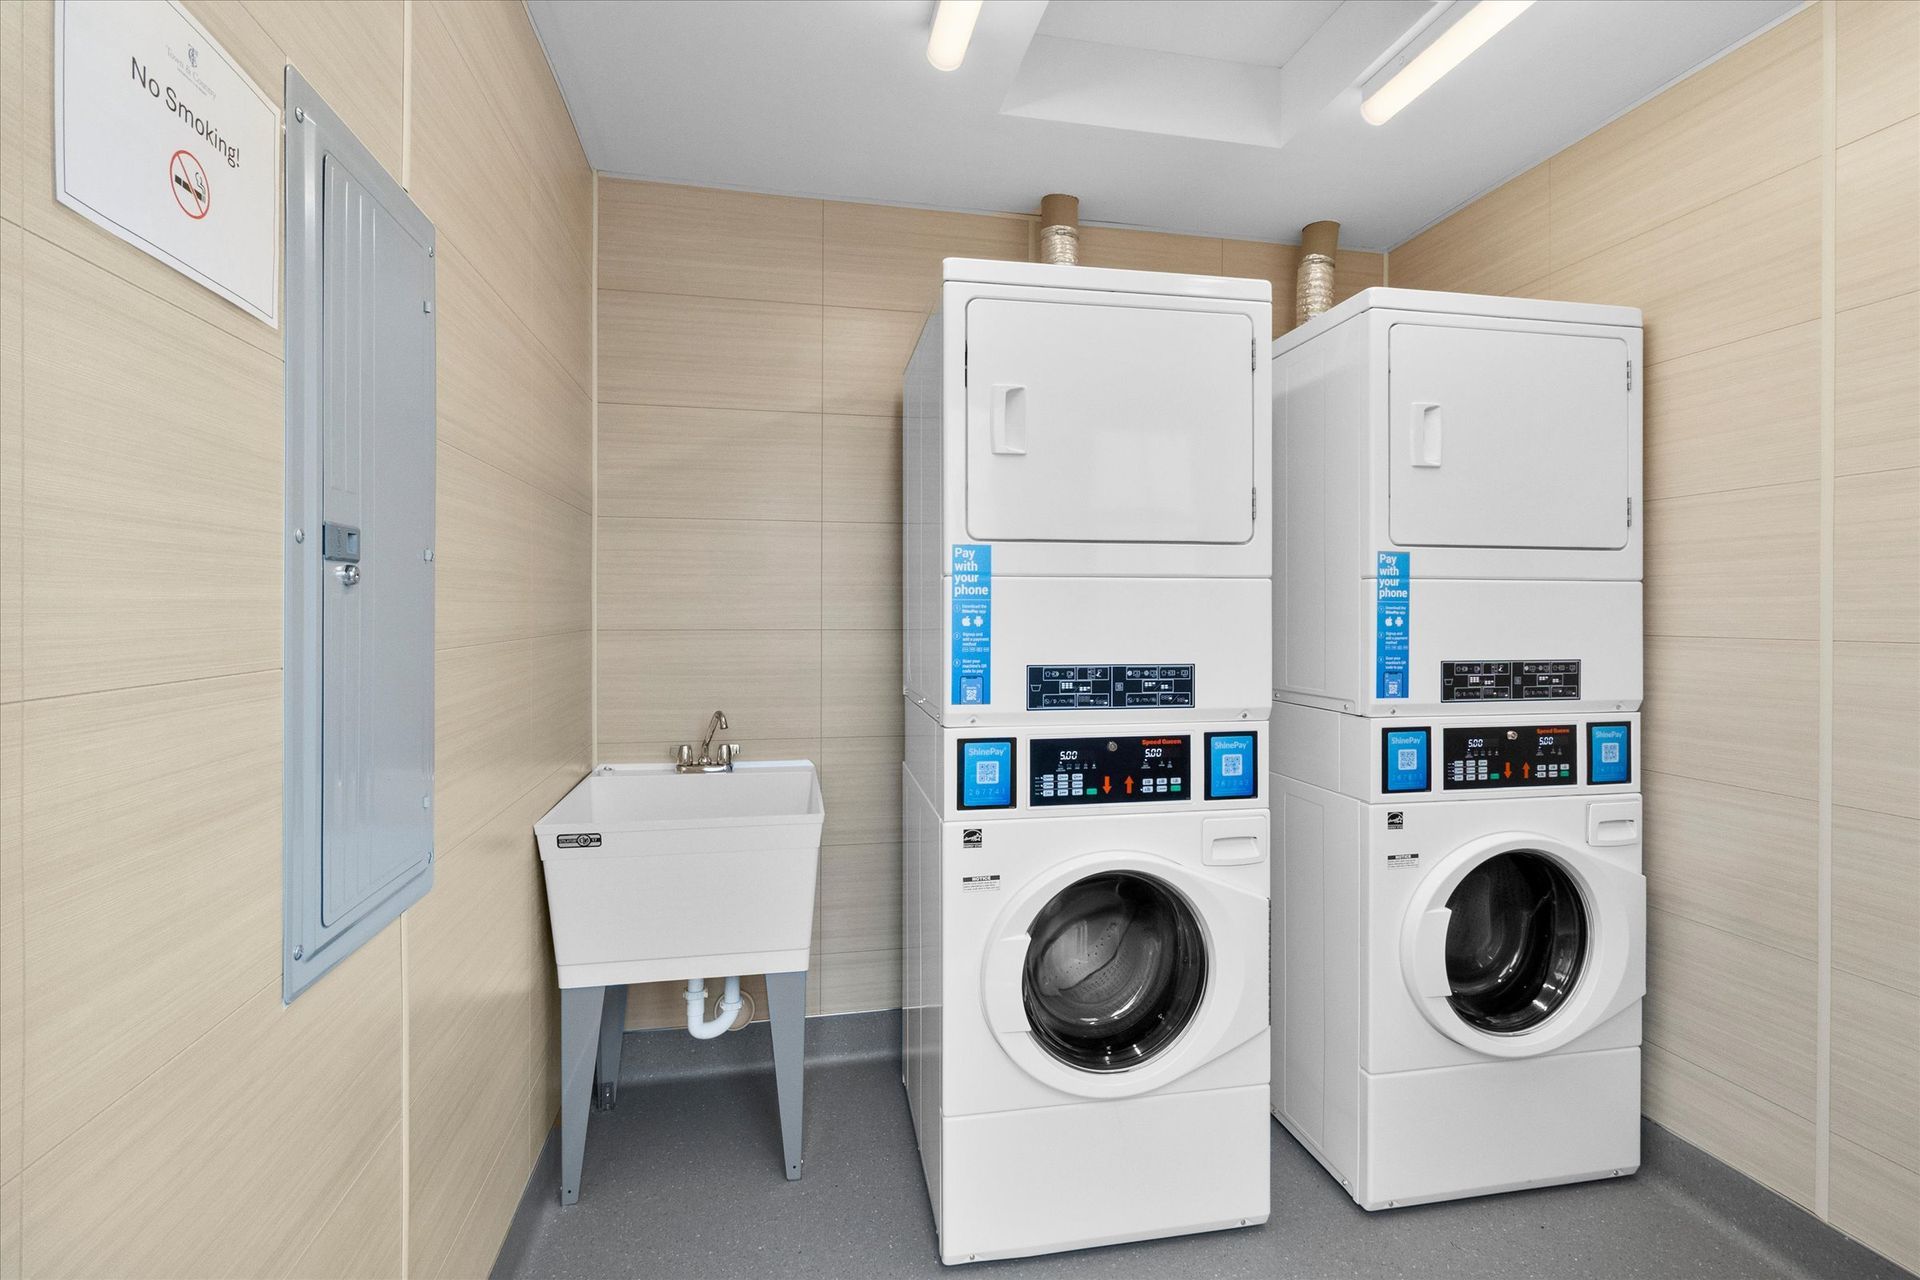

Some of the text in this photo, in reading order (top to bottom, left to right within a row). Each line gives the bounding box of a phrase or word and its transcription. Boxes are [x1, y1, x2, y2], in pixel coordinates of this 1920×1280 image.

[131, 56, 160, 98] No
[165, 87, 240, 168] Smoking!
[955, 547, 976, 560] Pay
[1379, 553, 1397, 566] Pay
[955, 560, 978, 572] with
[1379, 565, 1400, 576] with
[955, 573, 979, 585] your
[1379, 578, 1400, 588] your
[955, 584, 988, 598] phone
[1379, 587, 1408, 600] phone
[1214, 741, 1247, 750] ShinePay
[1391, 736, 1421, 744] ShinePay
[1468, 739, 1483, 748] 5.00
[1539, 736, 1554, 745] 5.00
[968, 747, 1005, 757] ShinePay
[1060, 750, 1078, 761] 5.00
[1145, 748, 1162, 758] 5.00
